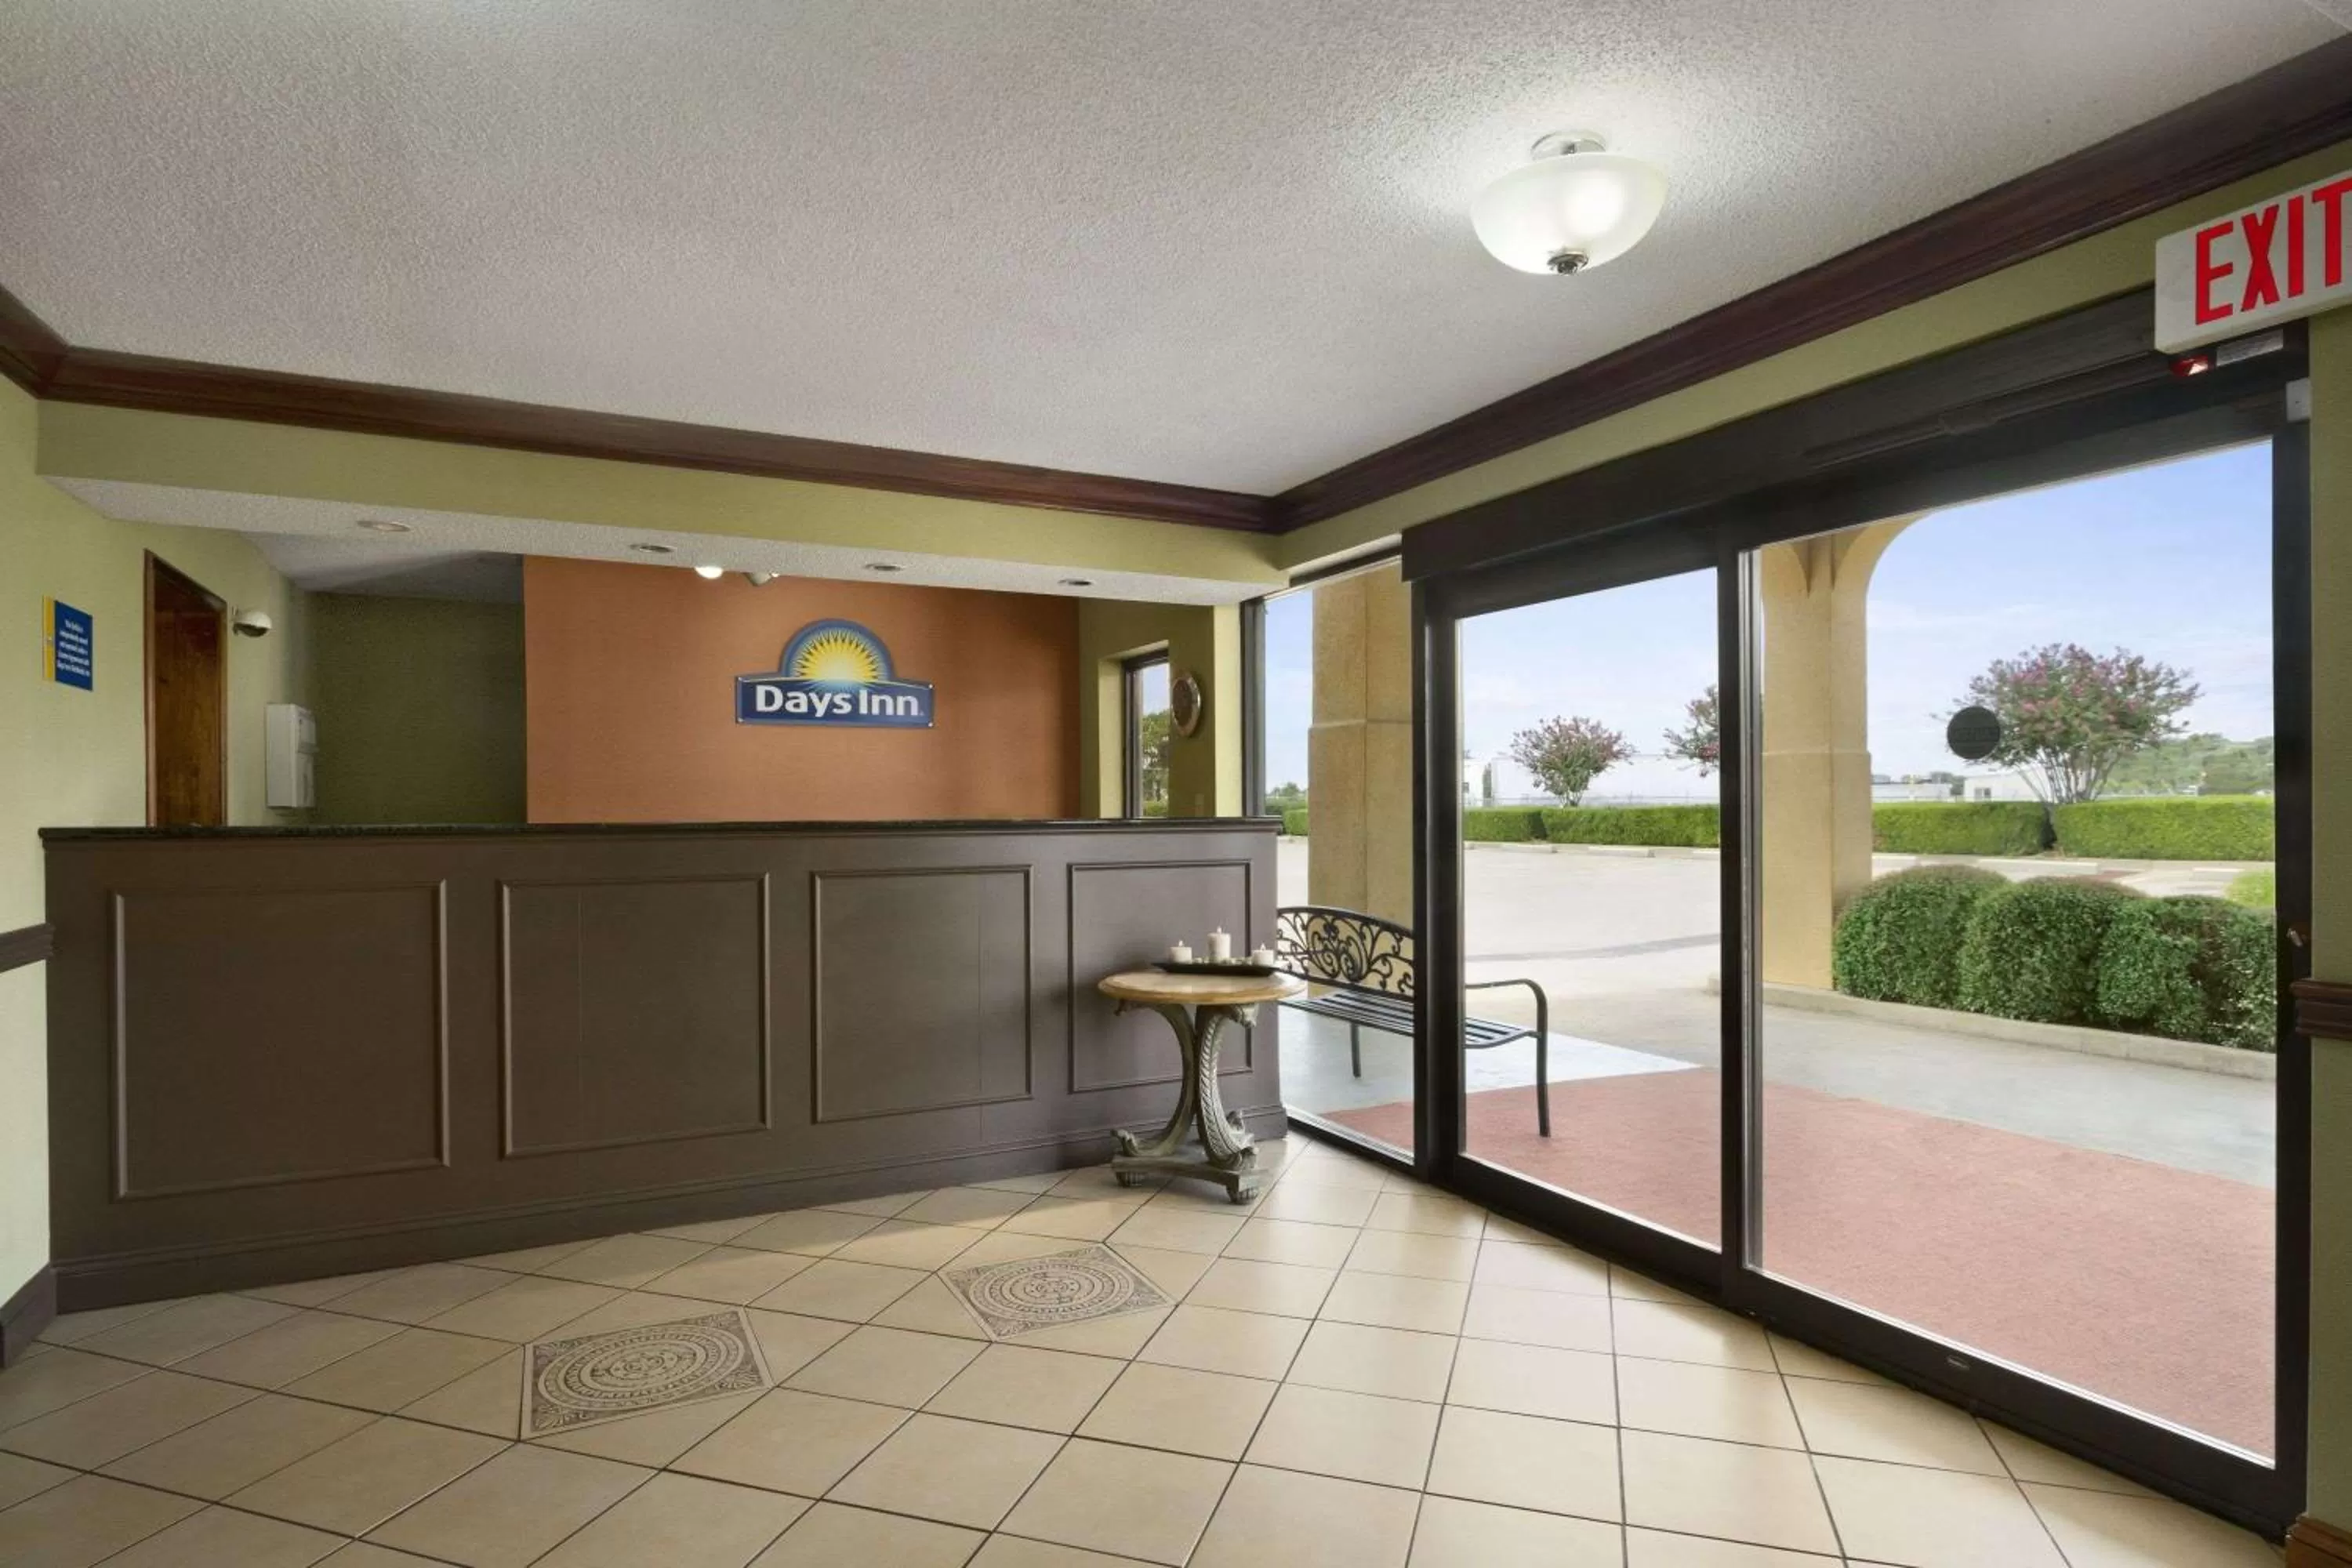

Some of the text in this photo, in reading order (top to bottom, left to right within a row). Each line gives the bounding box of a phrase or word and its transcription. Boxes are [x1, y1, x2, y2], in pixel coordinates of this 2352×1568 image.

[2196, 177, 2352, 325] EXIT
[755, 684, 920, 717] Days Inn
